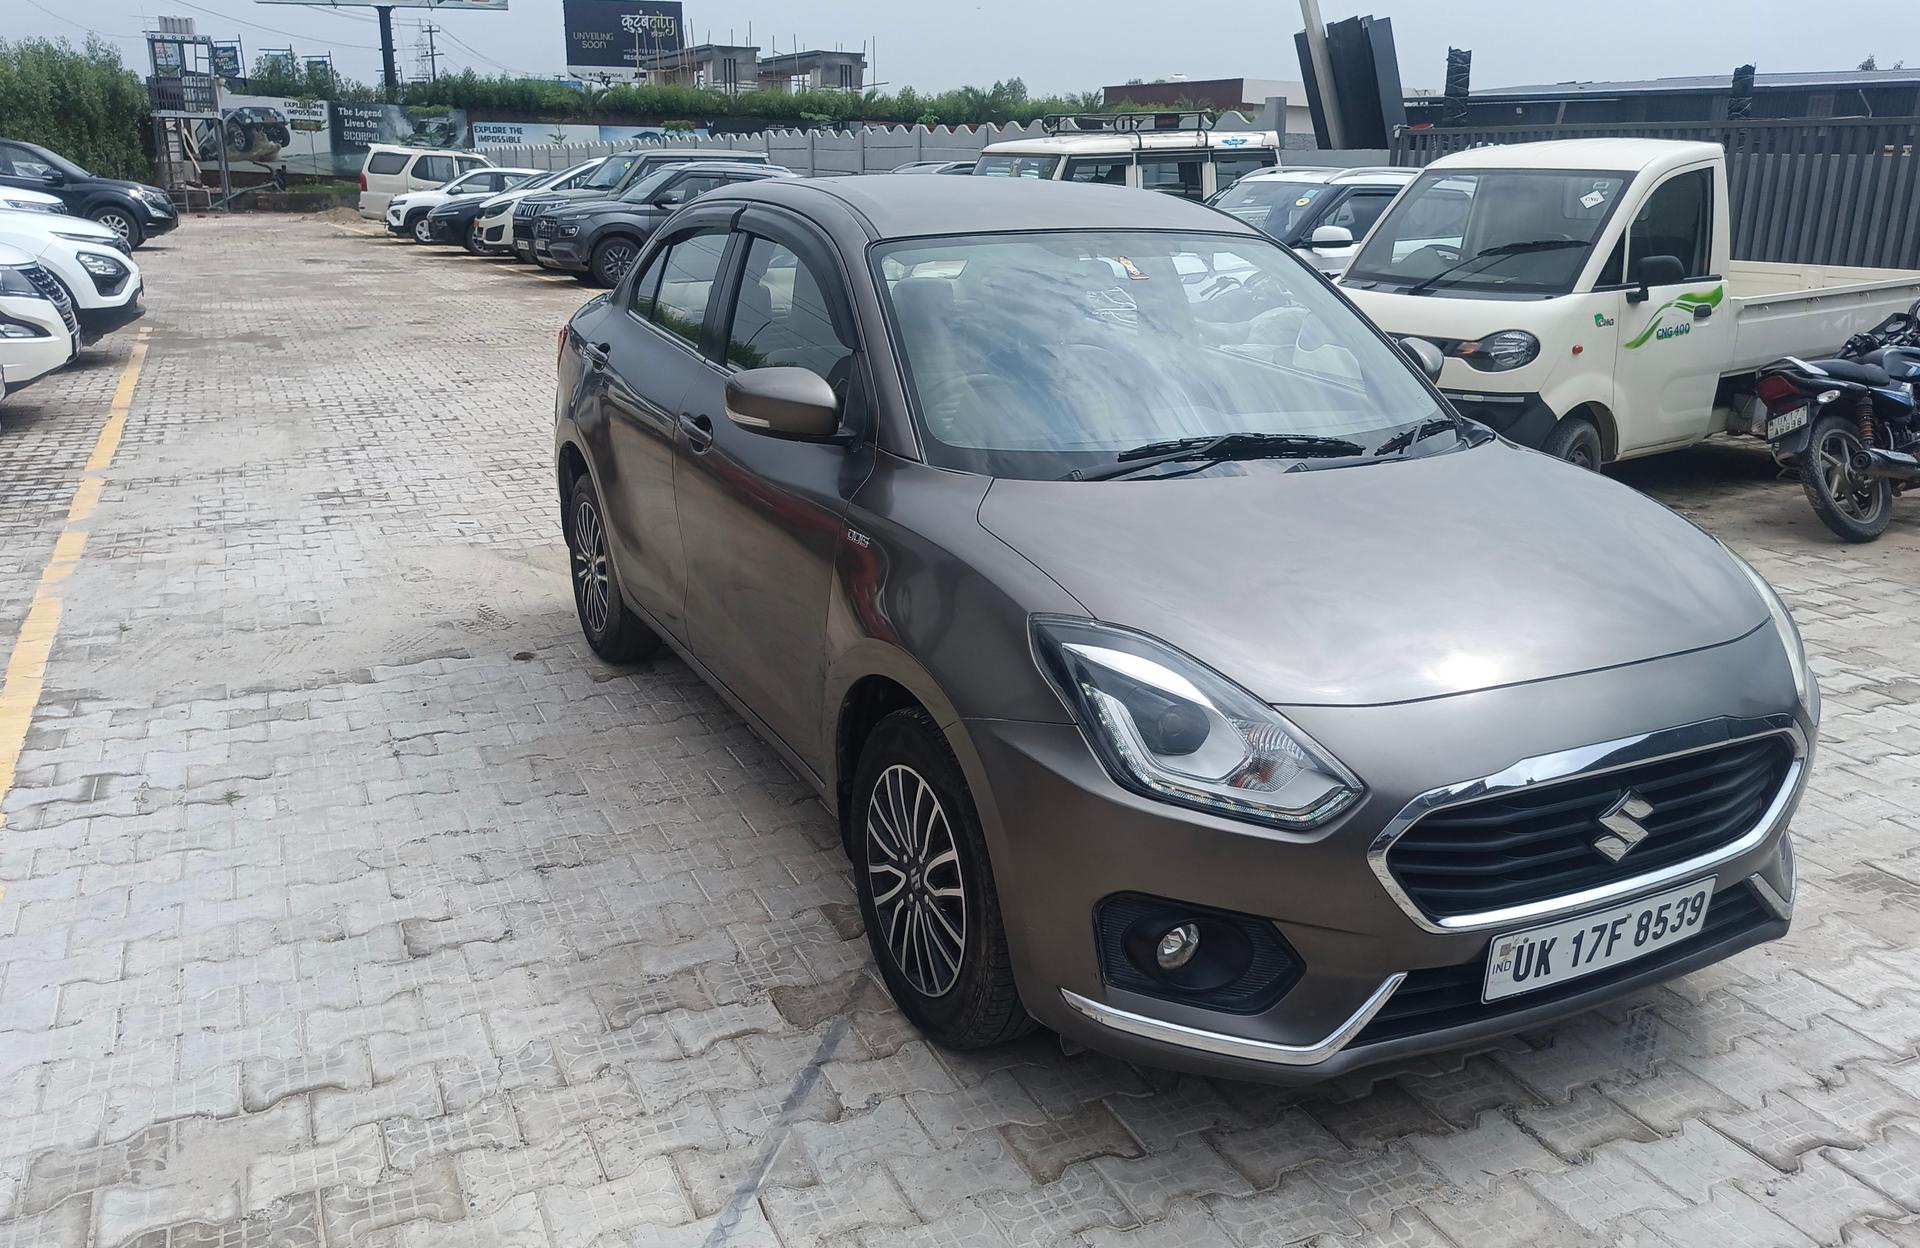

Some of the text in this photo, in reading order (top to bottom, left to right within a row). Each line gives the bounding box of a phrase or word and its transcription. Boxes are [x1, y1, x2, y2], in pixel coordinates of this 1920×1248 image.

[573, 31, 614, 41] UNVEILING
[337, 107, 382, 119] The Legend
[344, 119, 378, 129] Lives On
[474, 125, 523, 135] EXPLORE THE
[343, 131, 380, 141] SCORPIO
[478, 135, 522, 144] IMPOSSIBLE
[1512, 890, 1706, 982] UK 17F 8539
[1492, 959, 1512, 976] IND
